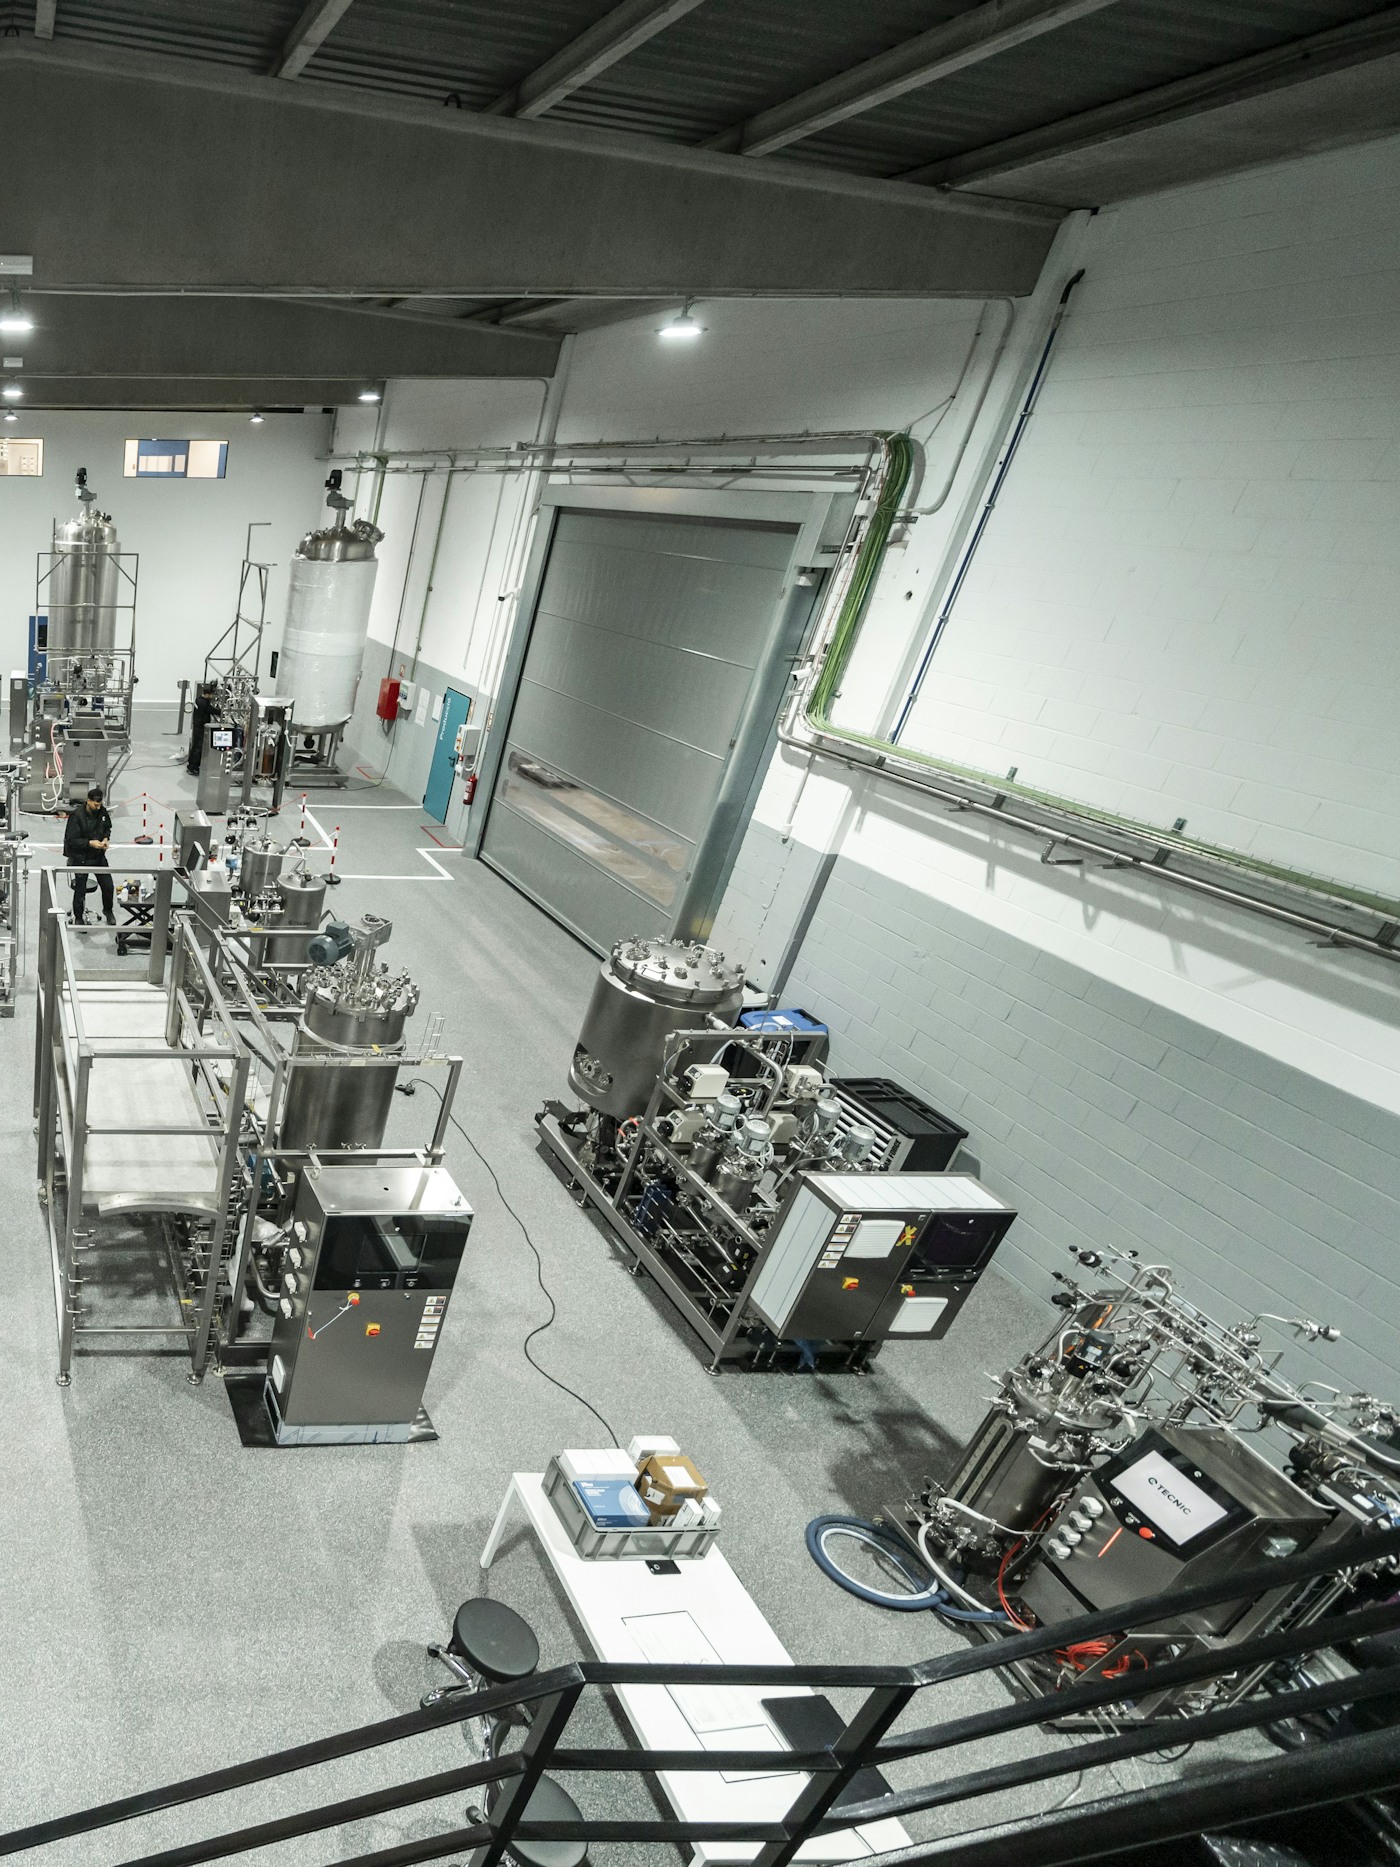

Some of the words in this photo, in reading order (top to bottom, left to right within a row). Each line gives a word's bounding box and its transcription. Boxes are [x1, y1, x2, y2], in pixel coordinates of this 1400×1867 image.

[439, 697, 452, 741] Producció
[888, 1138, 902, 1159] FORCE
[1157, 1484, 1192, 1515] TECNIC
